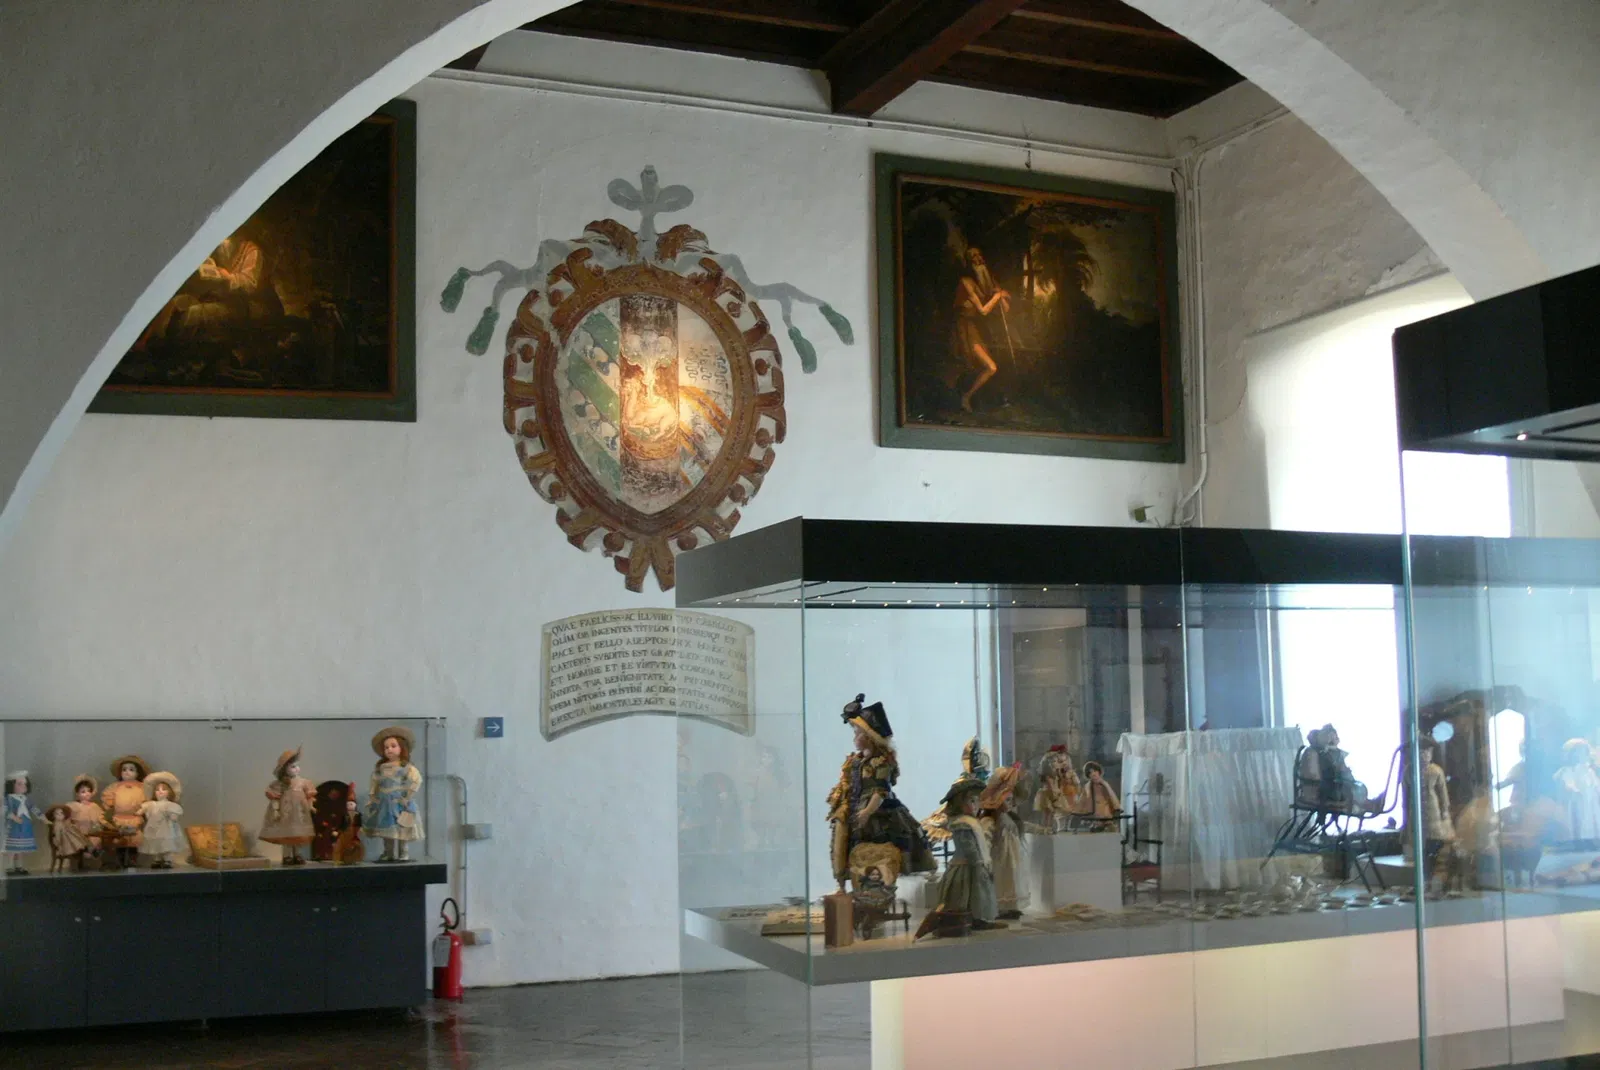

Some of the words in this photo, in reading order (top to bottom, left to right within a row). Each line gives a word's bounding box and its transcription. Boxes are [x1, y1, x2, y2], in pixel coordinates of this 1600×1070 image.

[551, 646, 574, 661] PACE
[577, 642, 591, 653] ET
[632, 649, 648, 657] EST
[551, 675, 564, 687] ET
[604, 663, 618, 672] ET
